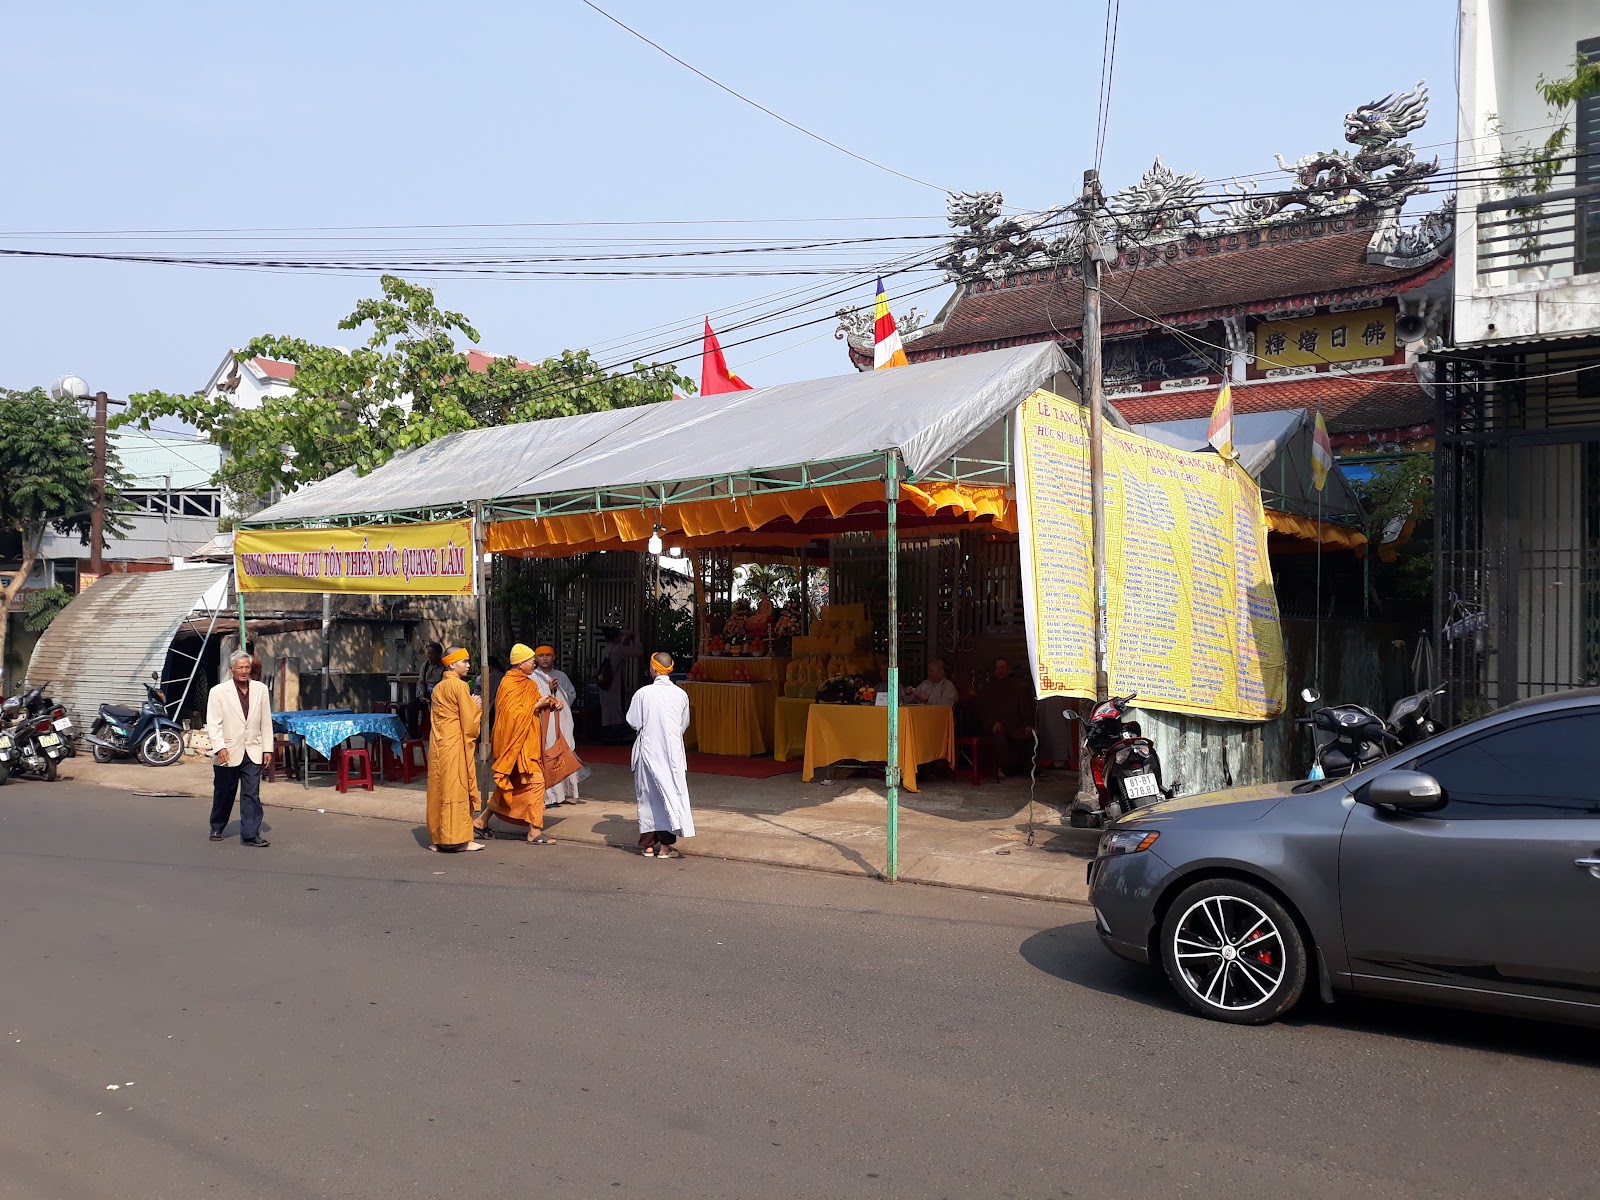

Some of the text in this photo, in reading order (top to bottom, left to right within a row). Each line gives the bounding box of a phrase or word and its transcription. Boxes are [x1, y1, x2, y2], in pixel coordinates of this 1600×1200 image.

[1053, 407, 1078, 425] TANG
[265, 552, 300, 576] NGHINH
[323, 544, 342, 577] TÔN
[377, 542, 399, 577] ĐỨC
[401, 547, 438, 583] QUANG
[440, 539, 465, 576] LÂM
[1129, 785, 1156, 797] 378.87
